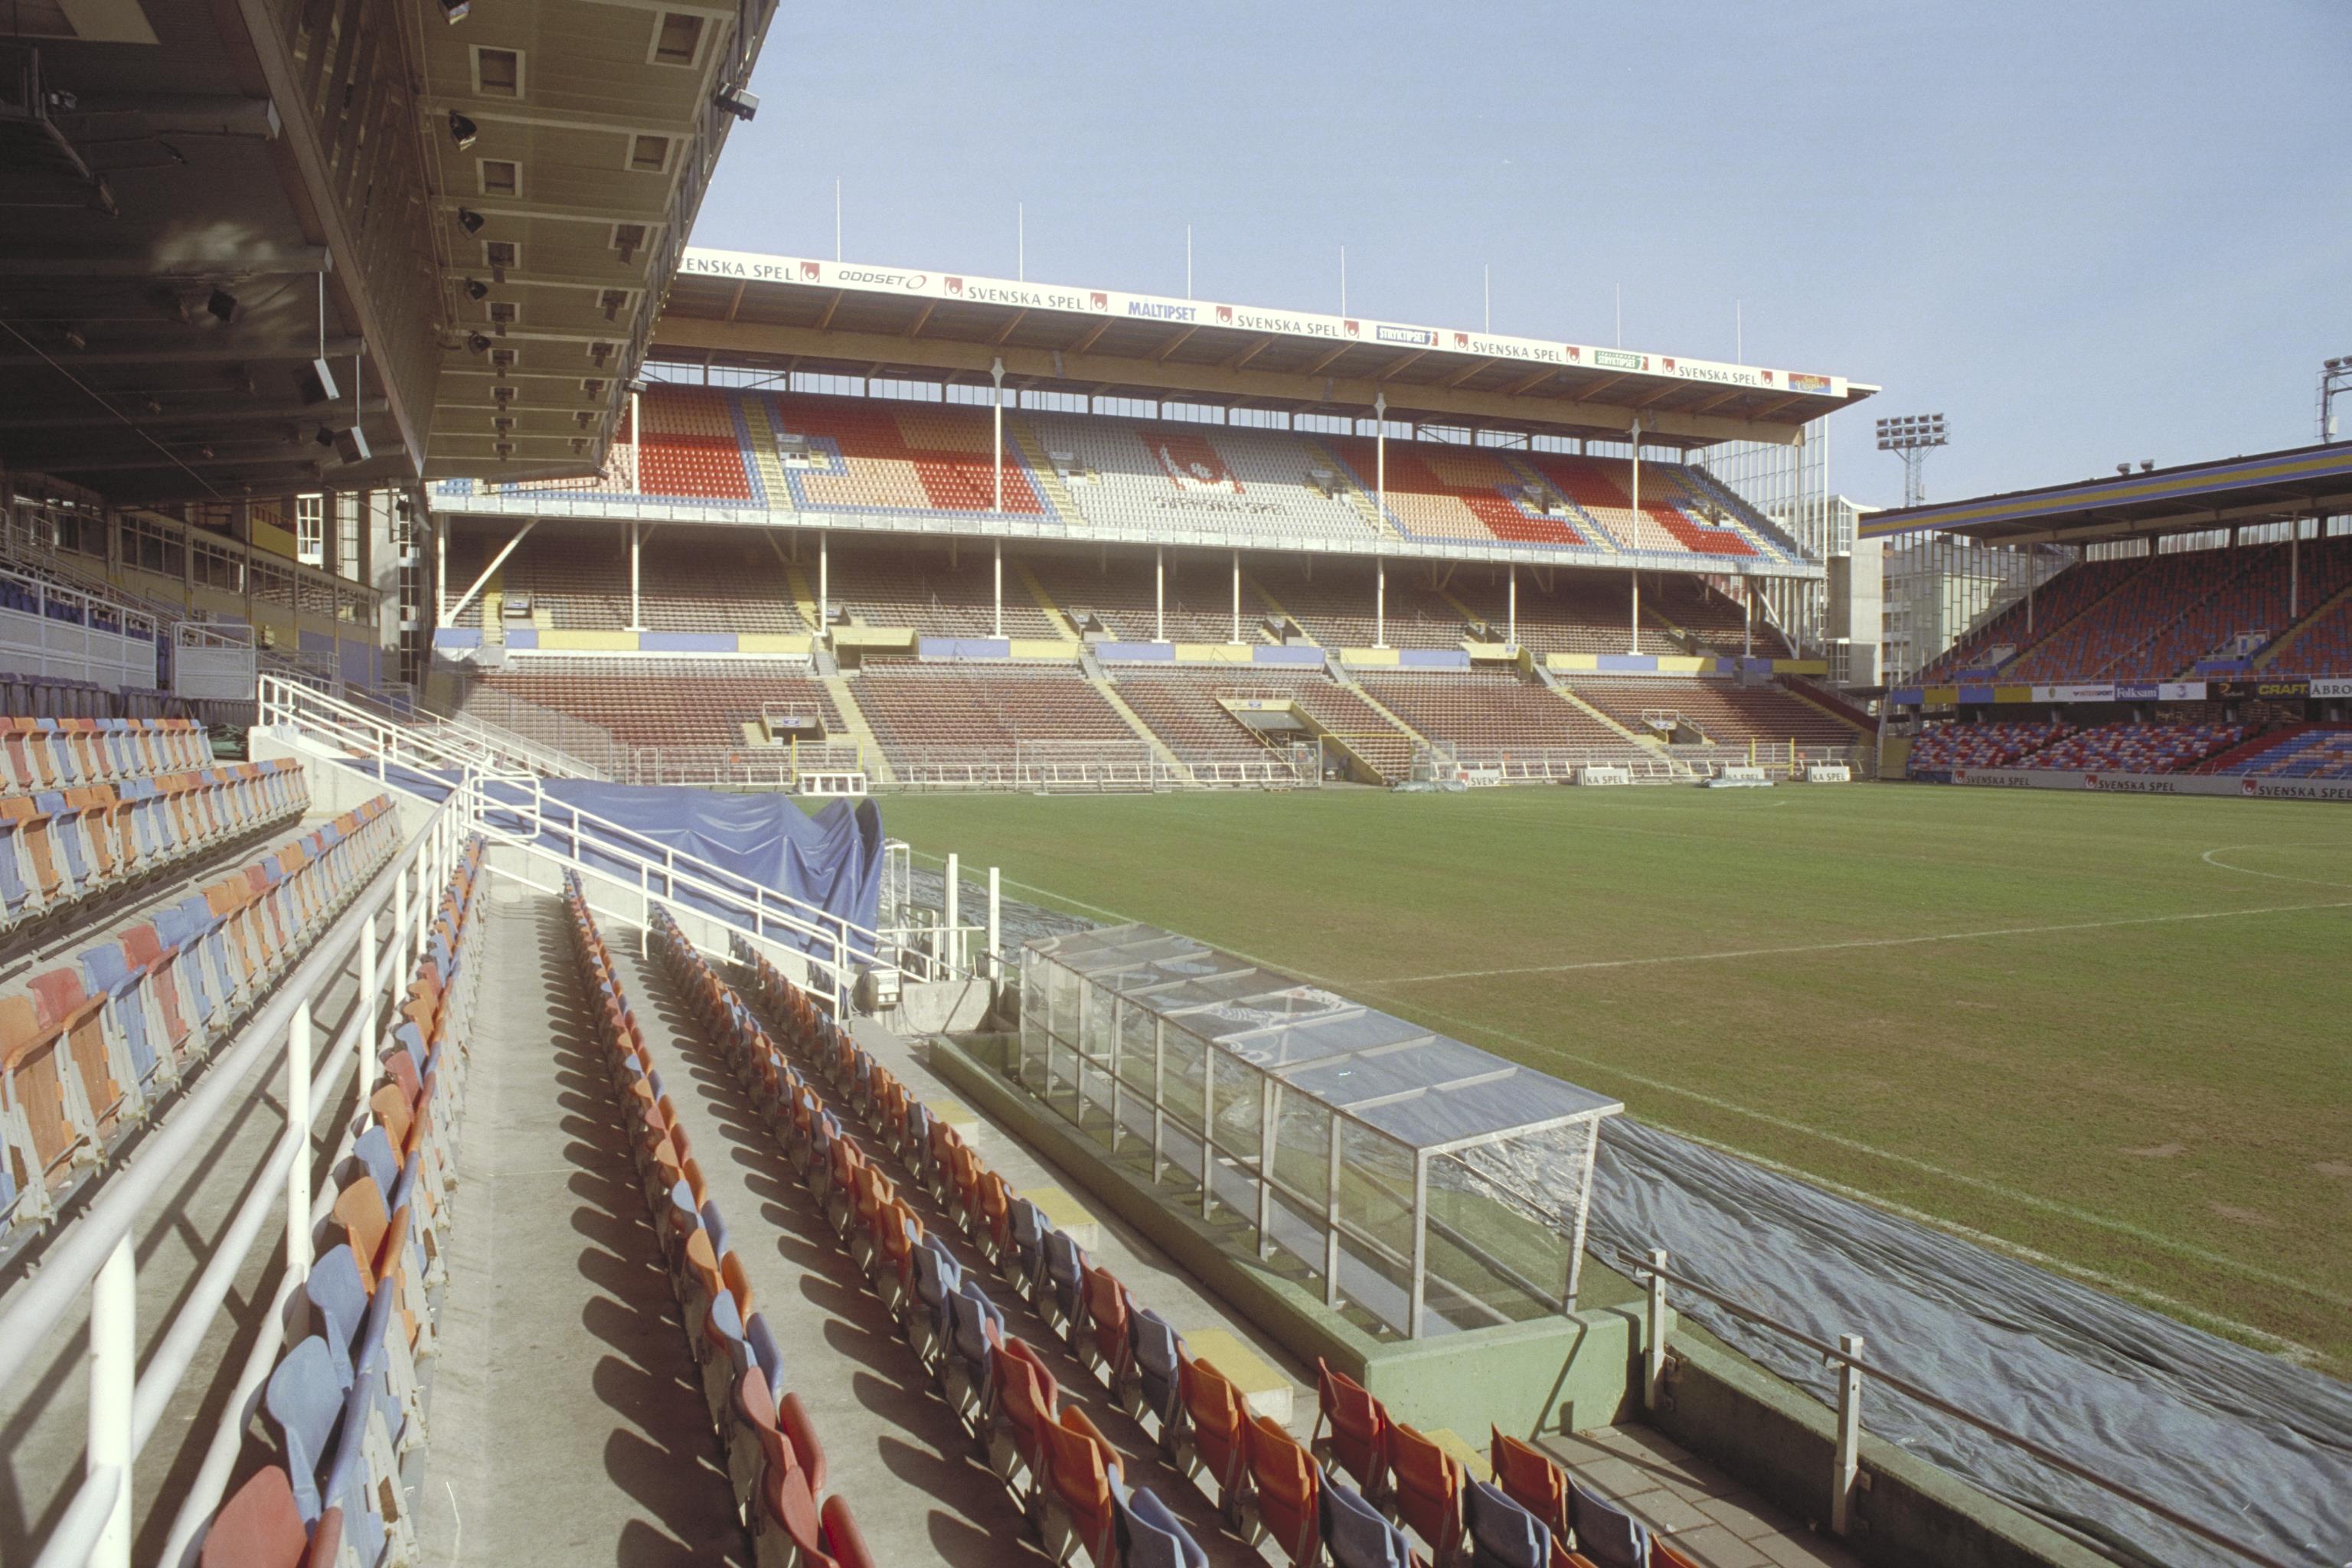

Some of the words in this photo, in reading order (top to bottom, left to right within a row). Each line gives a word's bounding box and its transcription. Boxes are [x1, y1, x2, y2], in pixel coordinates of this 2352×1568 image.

[753, 264, 794, 280] SPEL
[838, 270, 905, 286] ODDSET
[969, 286, 1041, 305] SVENSKA
[1048, 295, 1084, 310] SPEL
[1237, 315, 1301, 332] SVENSKA
[1307, 323, 1339, 337] SPEL
[1472, 341, 1529, 358] SVENSKA
[1534, 348, 1562, 361] SPEL
[1679, 366, 1728, 381] SVENSKA
[1733, 373, 1757, 385] SPEL
[2117, 687, 2158, 698] Folksam
[2259, 684, 2309, 695] CRAFT
[1586, 776, 1599, 784] KA
[1602, 775, 1623, 784] SPEL
[1827, 773, 1845, 781] SPEL
[1966, 776, 2004, 785] SVENSKA
[2008, 777, 2030, 786] SPEL
[2099, 780, 2145, 791] SVENSKA
[2149, 782, 2175, 792] SPEL
[2259, 786, 2316, 797] SVENSKA
